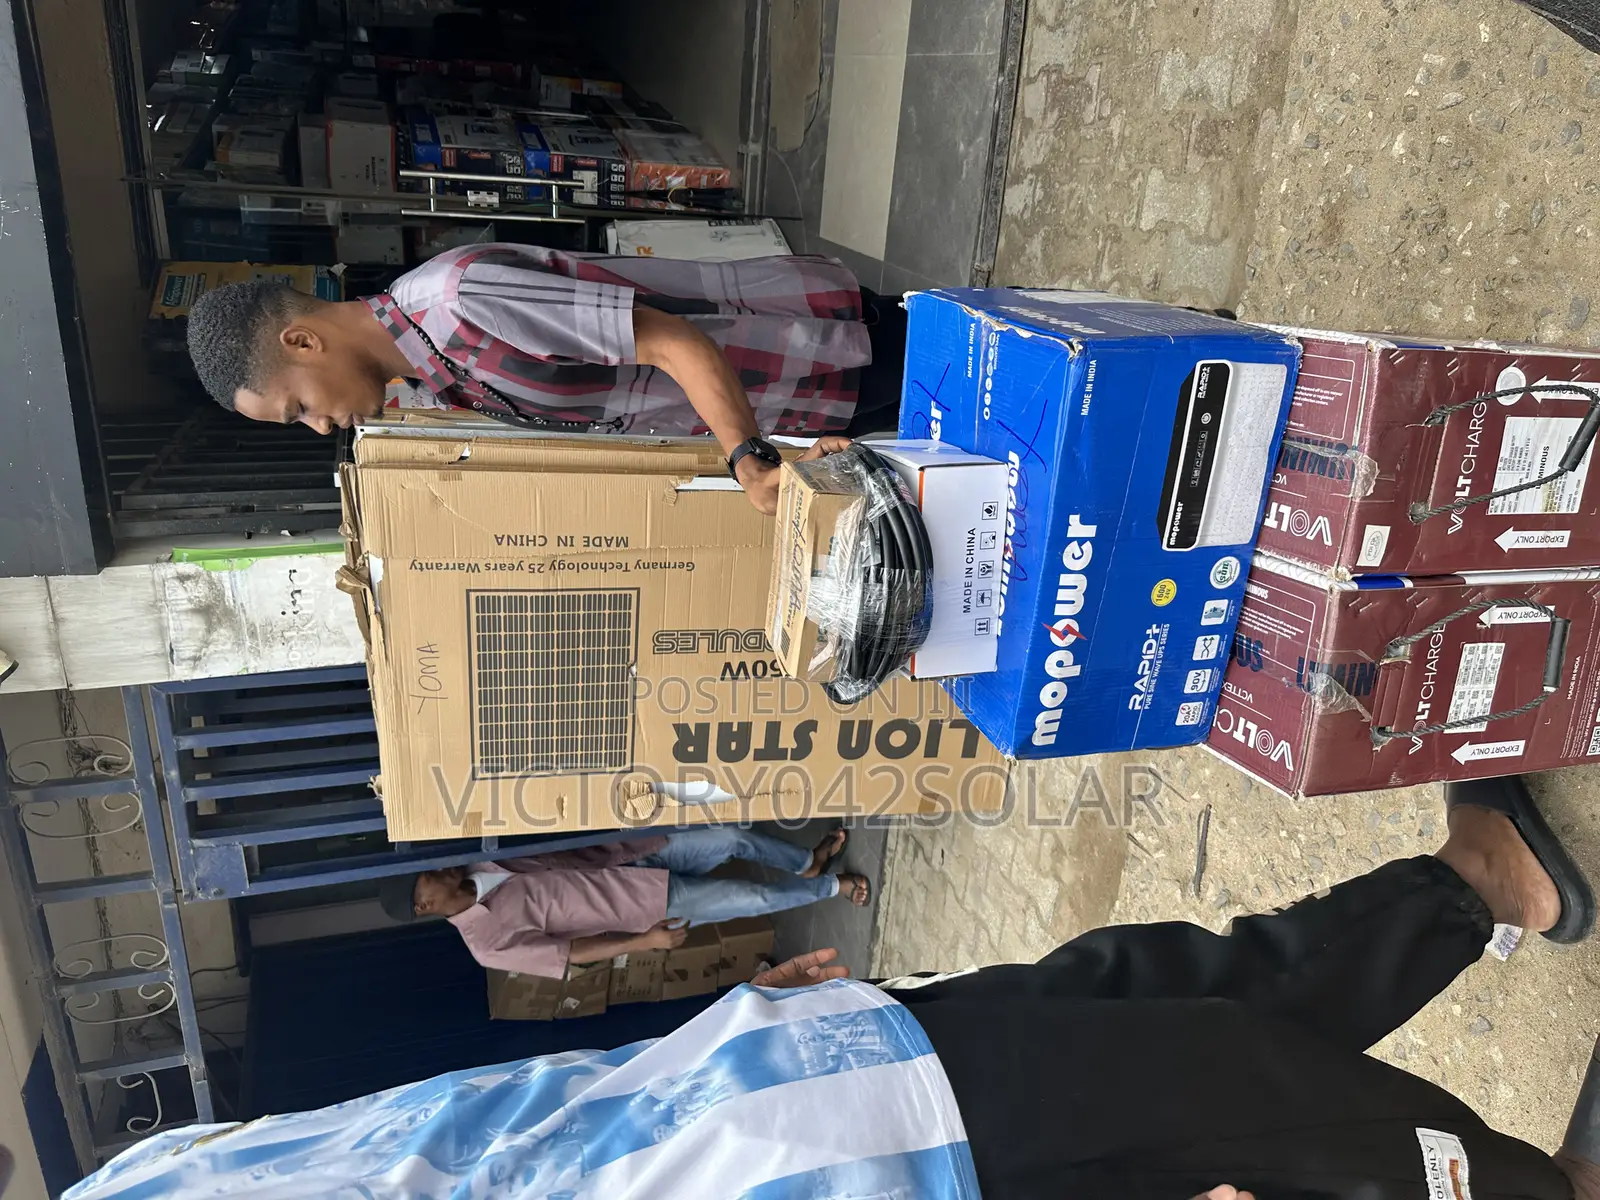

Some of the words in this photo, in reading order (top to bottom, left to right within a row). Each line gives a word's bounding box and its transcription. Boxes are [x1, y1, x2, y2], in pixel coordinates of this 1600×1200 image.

[968, 322, 976, 344] INDIA
[968, 345, 974, 354] IN
[1086, 359, 1097, 382] INDIA
[1084, 383, 1093, 392] IN
[1080, 393, 1091, 416] MADE
[930, 399, 942, 440] er
[1535, 445, 1550, 490] LMINOUS
[1272, 473, 1287, 485] VC
[1169, 501, 1184, 546] mopower
[493, 533, 549, 549] CHINA
[557, 534, 573, 549] IN
[581, 534, 629, 549] MADE
[964, 527, 976, 564] CHINA
[1515, 535, 1538, 544] ONLY
[1539, 535, 1565, 543] EXPORT
[409, 558, 481, 574] Warranty
[484, 558, 525, 572] years
[527, 562, 546, 574] 25
[550, 558, 630, 574] Technology
[635, 558, 696, 574] Germany
[963, 567, 974, 578] IN
[962, 581, 974, 614] MADE
[1156, 584, 1167, 603] 1600
[1497, 610, 1519, 618] ONLY
[1031, 513, 1098, 746] mopower
[1159, 623, 1170, 645] SERIES
[652, 628, 775, 655] DULES
[1156, 646, 1166, 659] UPS
[1128, 624, 1160, 710] RAPID+
[1152, 659, 1162, 678] WAVE
[1572, 655, 1581, 673] INDIA
[409, 640, 448, 714] YOMA
[1148, 678, 1158, 693] SINE
[1190, 672, 1201, 691] 90V
[1570, 673, 1577, 681] IN
[1567, 681, 1576, 700] MADE
[1143, 694, 1154, 710] PURE
[1190, 705, 1198, 722] RAPID
[671, 718, 819, 764] STAR
[837, 718, 980, 759] LION
[1471, 745, 1494, 754] ONLY
[1495, 744, 1520, 753] EXPORT
[1426, 1144, 1444, 1200] OLENLY
